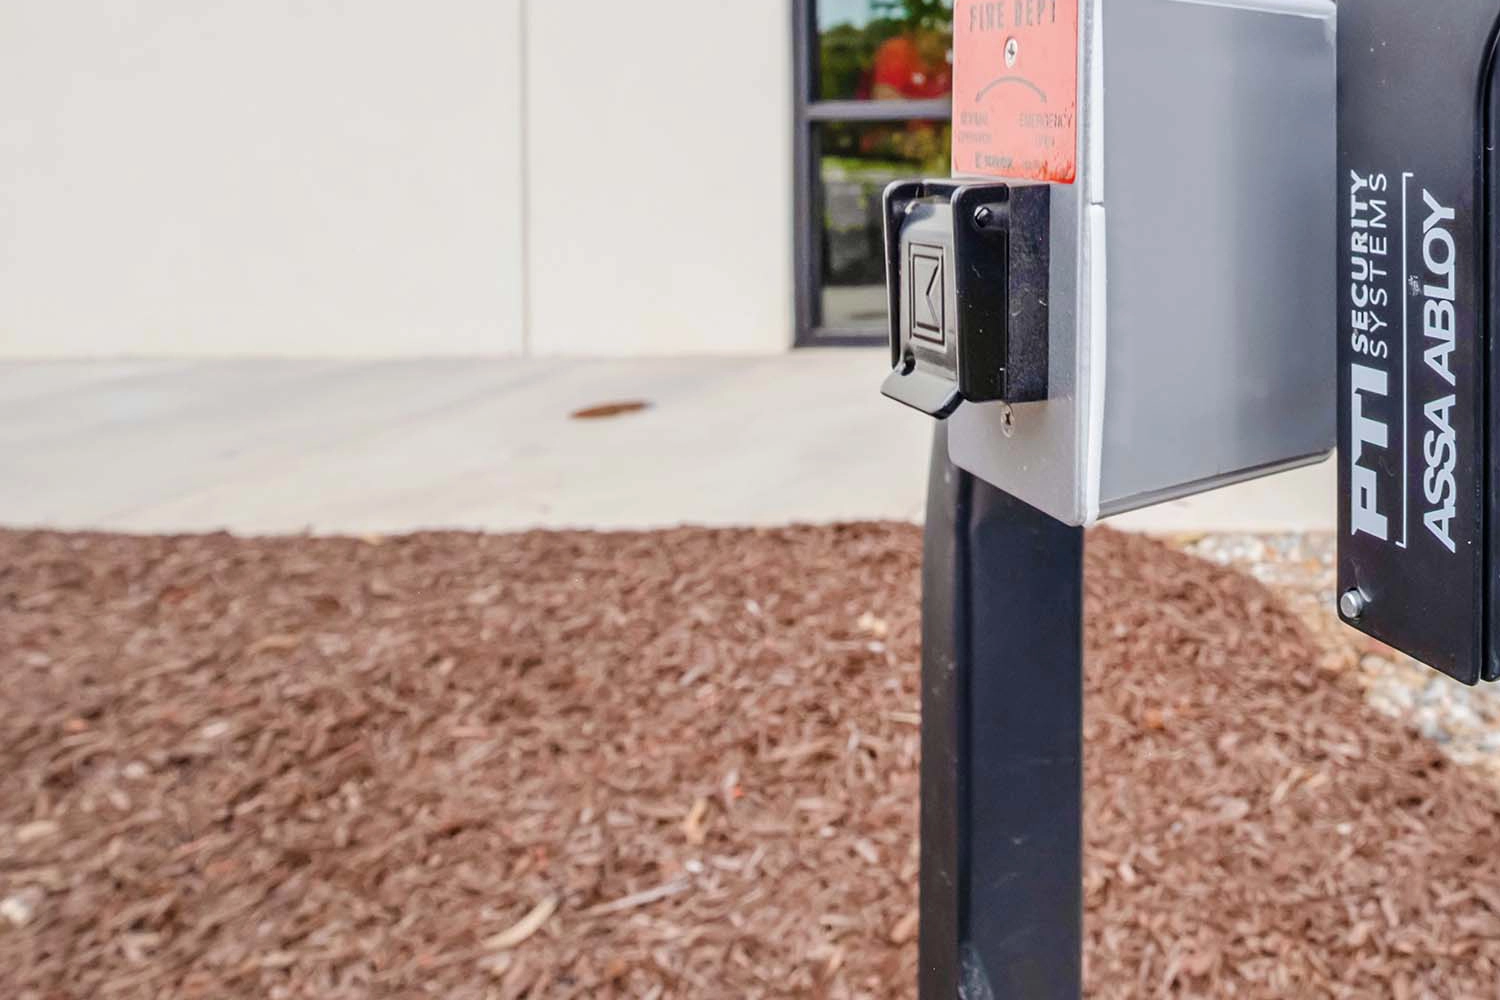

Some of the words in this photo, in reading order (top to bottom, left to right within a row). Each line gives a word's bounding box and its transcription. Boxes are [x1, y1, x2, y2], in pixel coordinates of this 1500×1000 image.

[969, 2, 1004, 33] FIRE
[1350, 169, 1369, 355] SECURITY
[1369, 173, 1388, 359] SYSTEMS
[1422, 187, 1456, 387] ABLOY
[1351, 363, 1388, 541] PTI
[1423, 394, 1457, 554] ASSA
